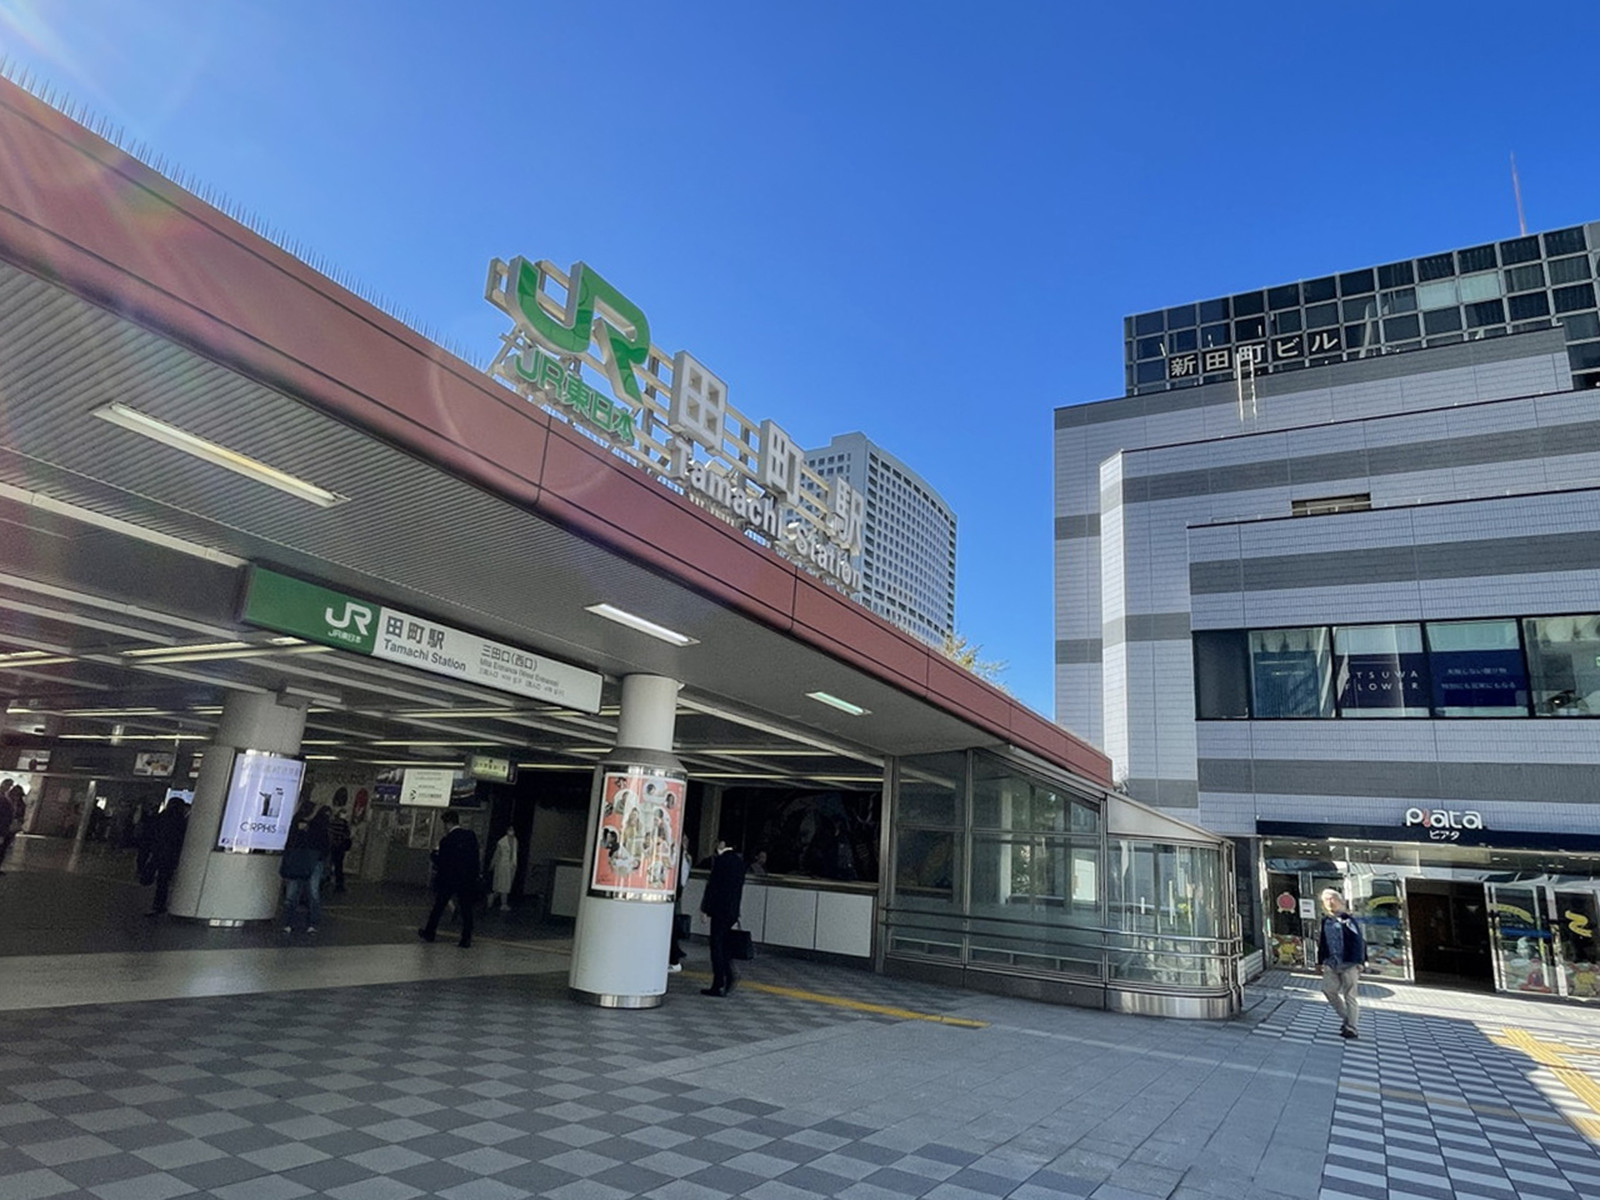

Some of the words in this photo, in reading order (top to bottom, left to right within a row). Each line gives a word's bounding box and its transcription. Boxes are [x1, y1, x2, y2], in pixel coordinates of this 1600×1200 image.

[506, 255, 651, 406] JR
[1170, 332, 1339, 377] 新田町ビル
[513, 348, 636, 444] JR東日本
[669, 350, 863, 556] 田町駅
[667, 438, 784, 540] Tamachi
[795, 526, 862, 592] Station
[325, 602, 372, 636] JR
[385, 616, 446, 650] 田町駅
[384, 638, 429, 661] Tamachi
[430, 652, 467, 671] Station
